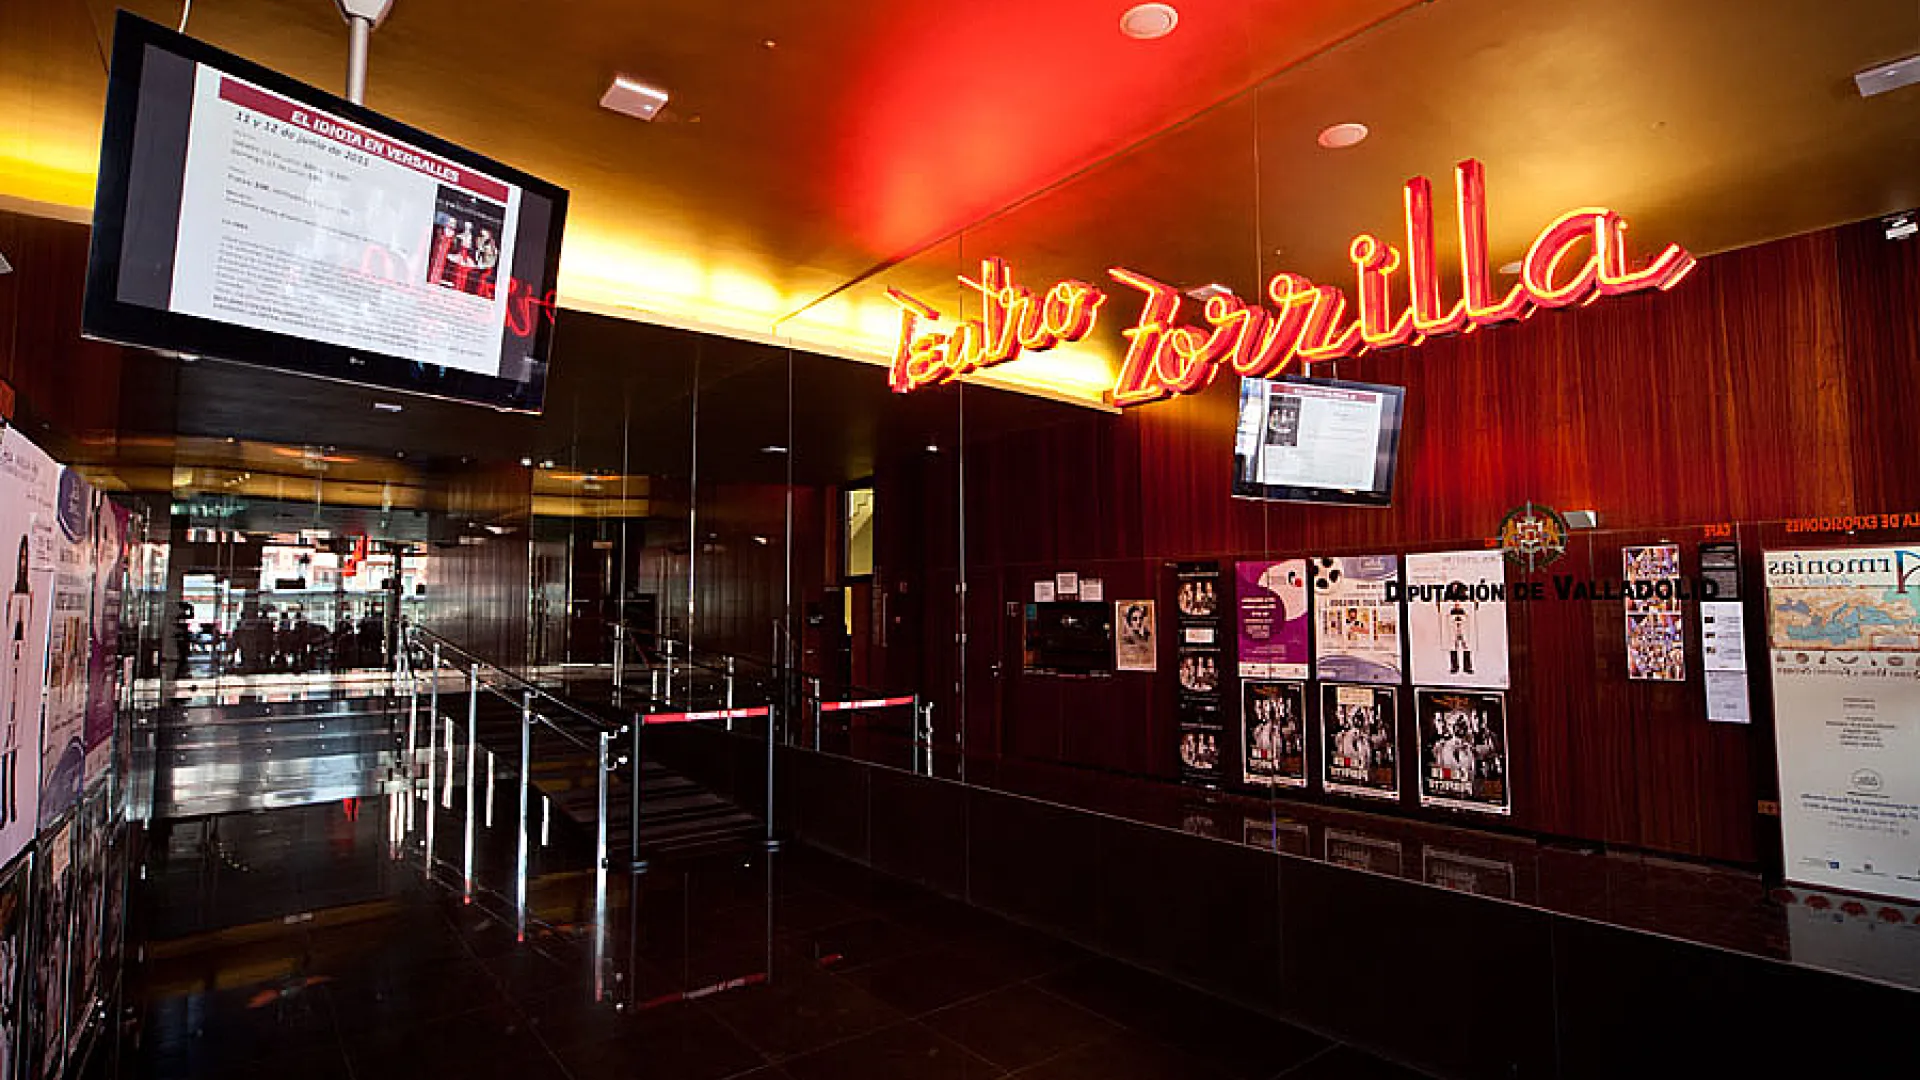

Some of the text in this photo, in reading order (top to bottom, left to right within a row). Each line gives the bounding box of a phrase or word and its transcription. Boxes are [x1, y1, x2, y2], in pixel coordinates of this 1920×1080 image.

[281, 125, 295, 139] de
[297, 132, 327, 151] junio
[328, 144, 343, 157] de
[292, 110, 460, 184] EL IDIOTA EN VERSALLES
[884, 158, 1697, 408] Teatro Zorrilla
[1385, 578, 1504, 602] DIPUTACIÓN
[1513, 582, 1545, 601] DE
[1553, 575, 1721, 602] VALLADOLID
